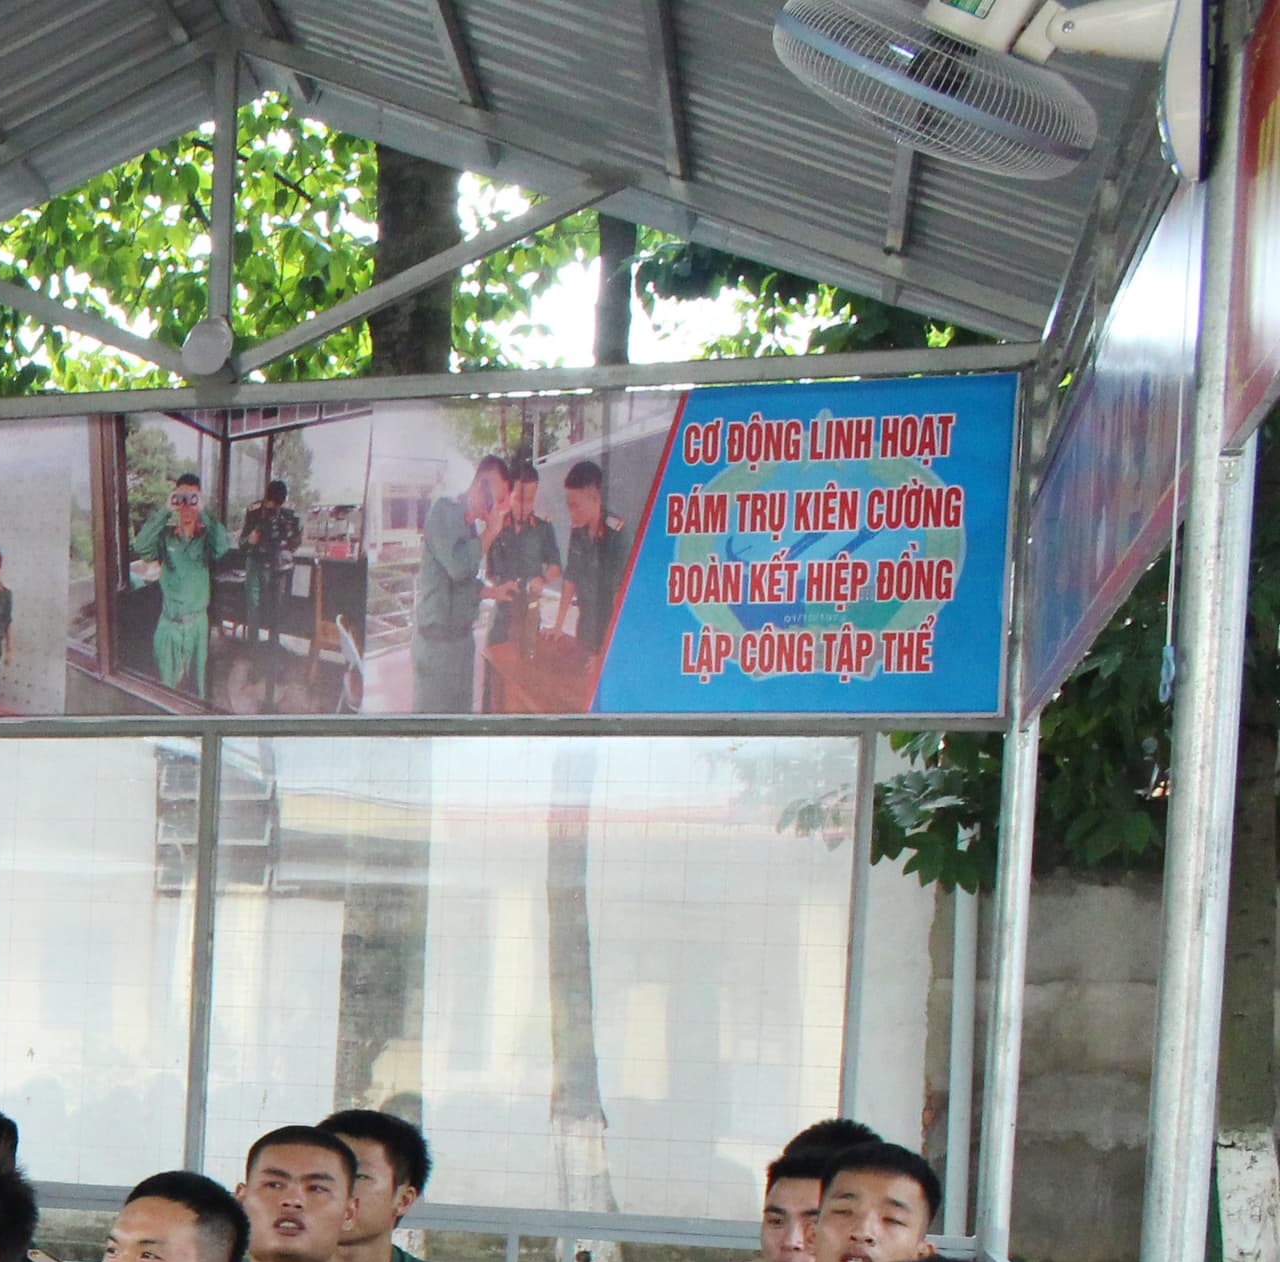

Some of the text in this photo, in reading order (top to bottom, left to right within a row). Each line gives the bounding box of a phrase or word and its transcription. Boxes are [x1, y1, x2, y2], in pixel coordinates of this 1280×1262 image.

[683, 411, 956, 472] CƠ ĐỘNG LINH HOẠT
[666, 478, 963, 541] BÁM TRỤ KIÊN CƯỜNG
[668, 542, 954, 611] ĐOÀN KẾT HIỆP ĐỒNG
[681, 615, 935, 683] LẬP CÔNG TẬP THỂ
